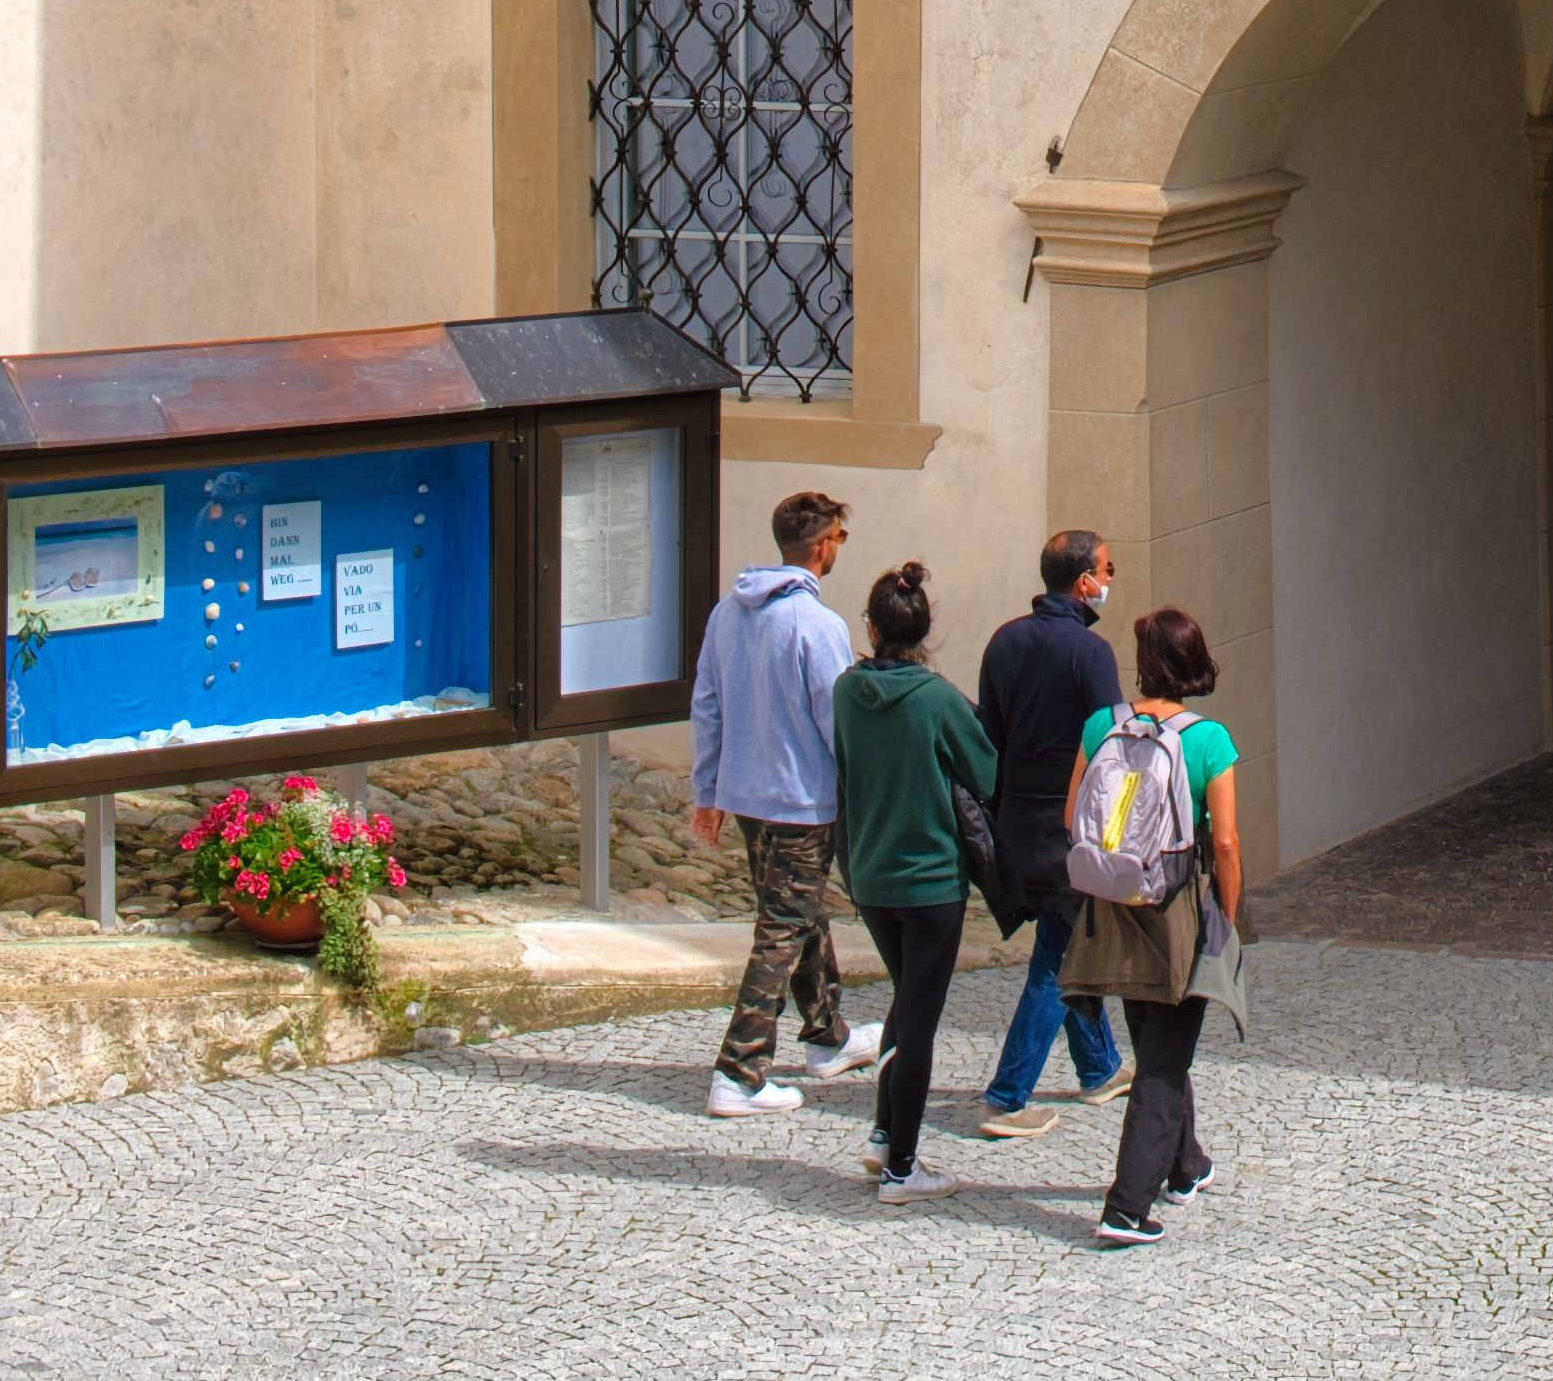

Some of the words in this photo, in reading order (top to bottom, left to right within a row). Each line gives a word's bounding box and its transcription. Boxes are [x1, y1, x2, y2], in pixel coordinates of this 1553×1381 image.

[270, 516, 289, 528] BIN
[270, 535, 300, 548] DANN
[270, 554, 294, 567] MAL
[343, 564, 374, 577] VADO
[270, 573, 295, 586] WEG
[343, 585, 363, 596] VIA
[344, 603, 366, 615] PER
[368, 601, 382, 613] UN
